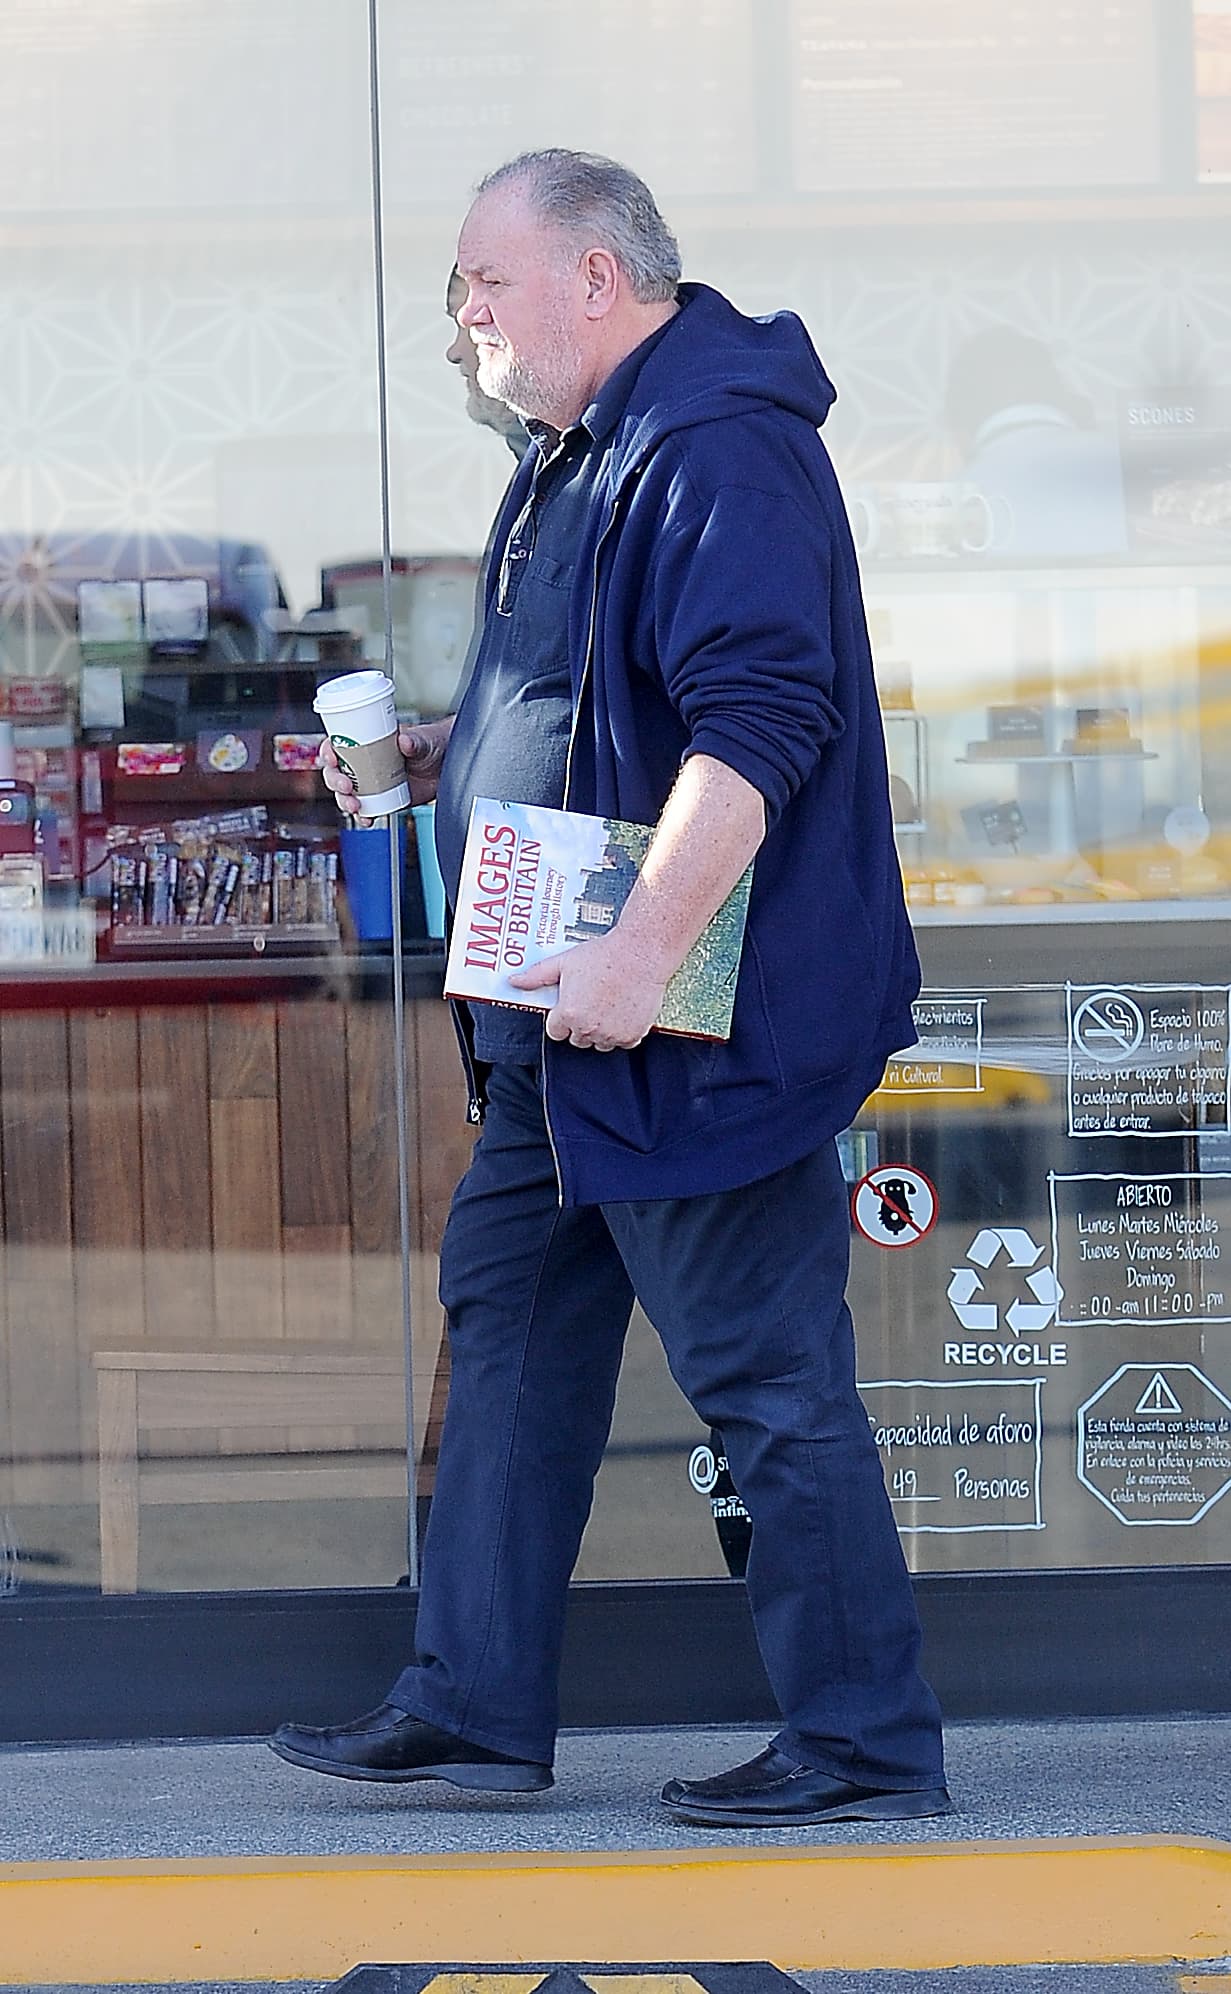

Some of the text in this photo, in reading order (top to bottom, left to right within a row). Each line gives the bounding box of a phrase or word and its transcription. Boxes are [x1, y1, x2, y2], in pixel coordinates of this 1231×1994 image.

[1127, 407, 1194, 425] SCONES
[508, 839, 542, 936] BRITAIN
[542, 867, 558, 901] Journey
[464, 824, 517, 972] IMAGES
[546, 873, 567, 945] Through History
[536, 902, 550, 939] Pictorial
[503, 937, 527, 967] OF
[1150, 1008, 1226, 1033] Espacio 100%
[1178, 1033, 1190, 1052] de
[1073, 1061, 1227, 1087] Gracias por apagar tu cigarro
[1073, 1085, 1227, 1114] o cualquier producto de tabaco
[1103, 1110, 1117, 1129] de
[1116, 1184, 1172, 1207] ABIERTO
[1077, 1211, 1219, 1235] Lunes Martes Miércoles
[1079, 1237, 1221, 1262] Jueves Viernes Sábado
[1126, 1265, 1176, 1294] Domingo
[943, 1343, 1067, 1365] RECYCLE
[958, 1413, 980, 1446] de
[986, 1412, 1033, 1445] aforo
[1087, 1418, 1108, 1433] Esta
[1167, 1421, 1184, 1433] con
[1185, 1417, 1217, 1433] sistema
[1218, 1417, 1229, 1433] de
[1157, 1440, 1165, 1456] y
[1086, 1453, 1099, 1468] En
[1130, 1457, 1146, 1468] con
[1147, 1453, 1156, 1468] la
[1186, 1458, 1194, 1473] y
[893, 1468, 1030, 1499] 49 Personas
[1125, 1470, 1137, 1486] de
[1137, 1491, 1151, 1503] tus
[712, 1502, 750, 1518] infin
